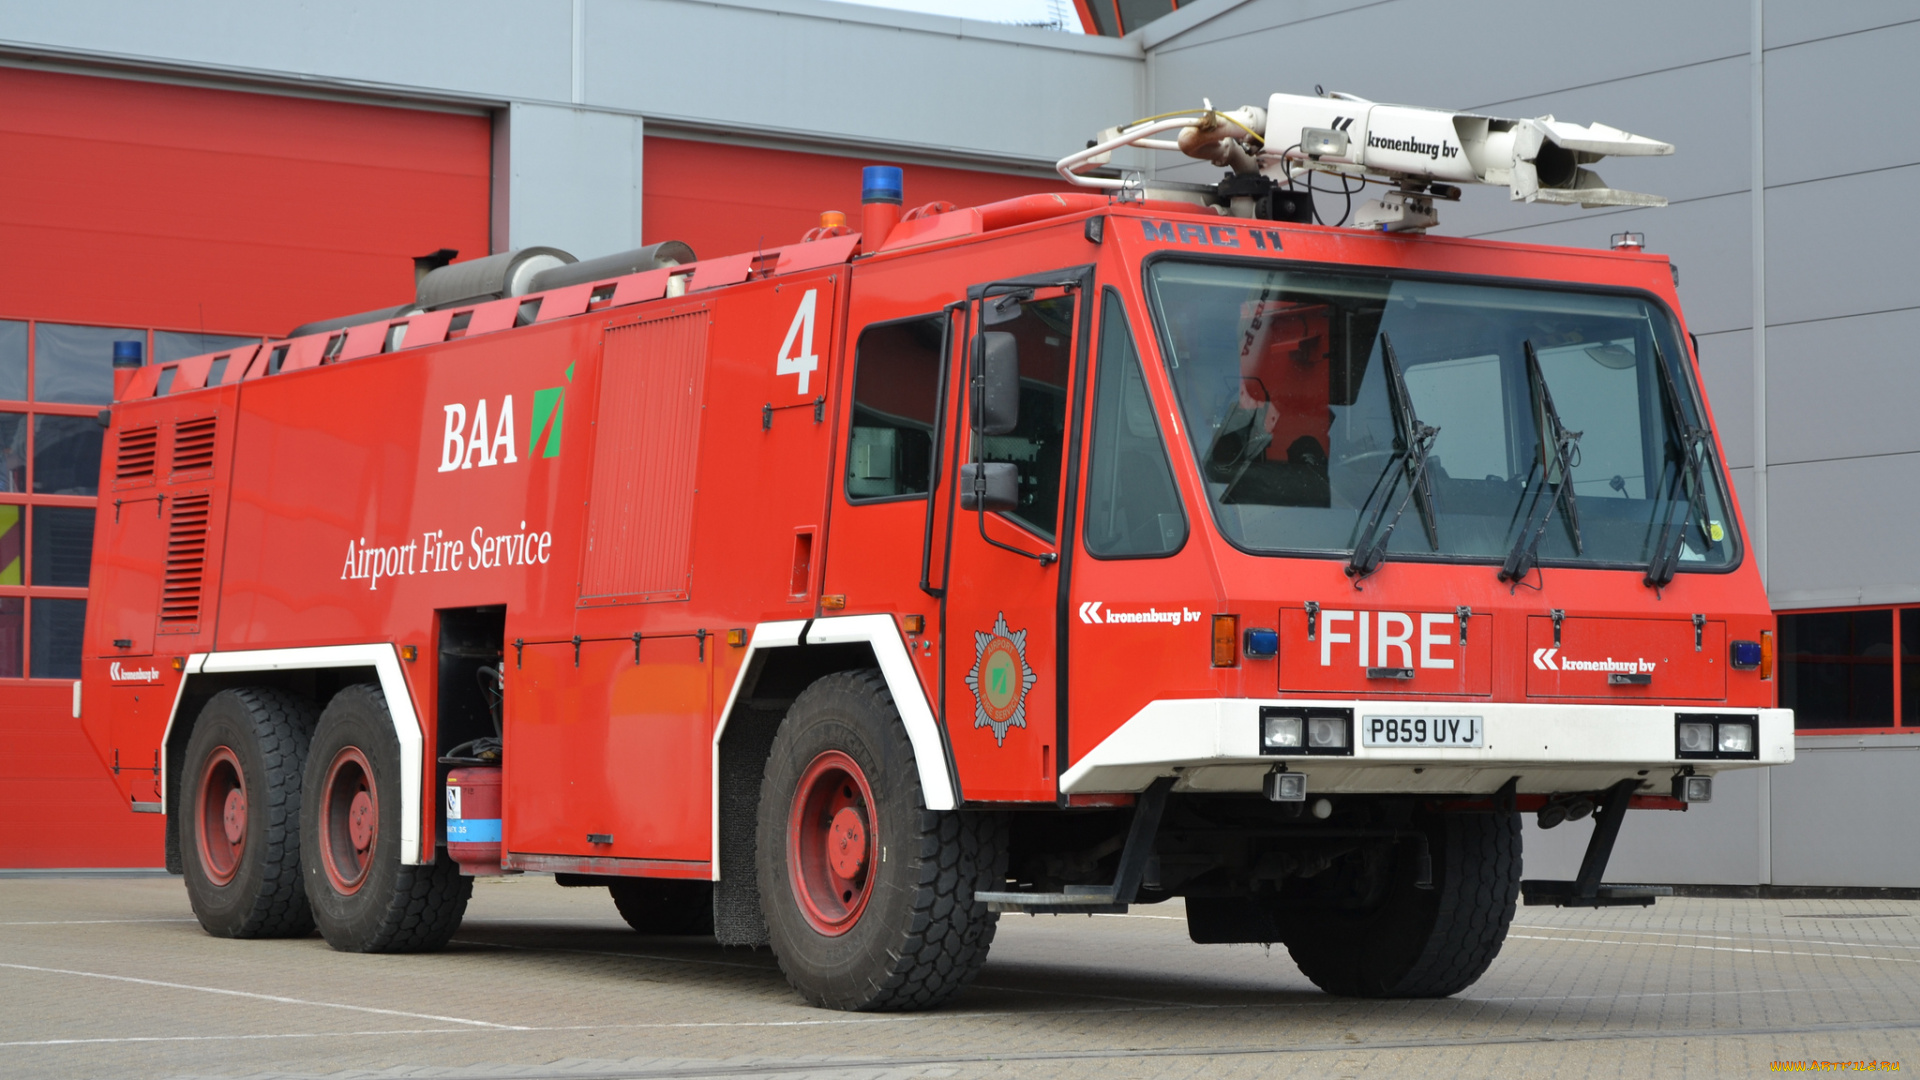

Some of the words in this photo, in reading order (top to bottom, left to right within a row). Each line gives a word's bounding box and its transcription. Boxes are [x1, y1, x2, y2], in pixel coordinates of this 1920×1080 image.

[1367, 130, 1440, 160] kronenburg
[1442, 140, 1459, 158] bv
[1140, 220, 1241, 248] MAC
[1249, 229, 1284, 251] 11
[777, 288, 819, 395] 4
[437, 394, 518, 473] BAA
[340, 536, 417, 591] Airport
[419, 528, 464, 574] Fire
[468, 520, 552, 571] Service
[1106, 608, 1182, 626] kronenburg
[1183, 607, 1201, 622] bv
[987, 639, 1015, 655] AIRPORT
[1320, 609, 1455, 669] FIRE
[1561, 656, 1637, 674] kronenburg
[1638, 657, 1656, 672] bv
[981, 693, 994, 716] FIRE
[995, 694, 1020, 720] SERVICE
[1371, 718, 1427, 743] P859
[1433, 719, 1474, 743] UYJ
